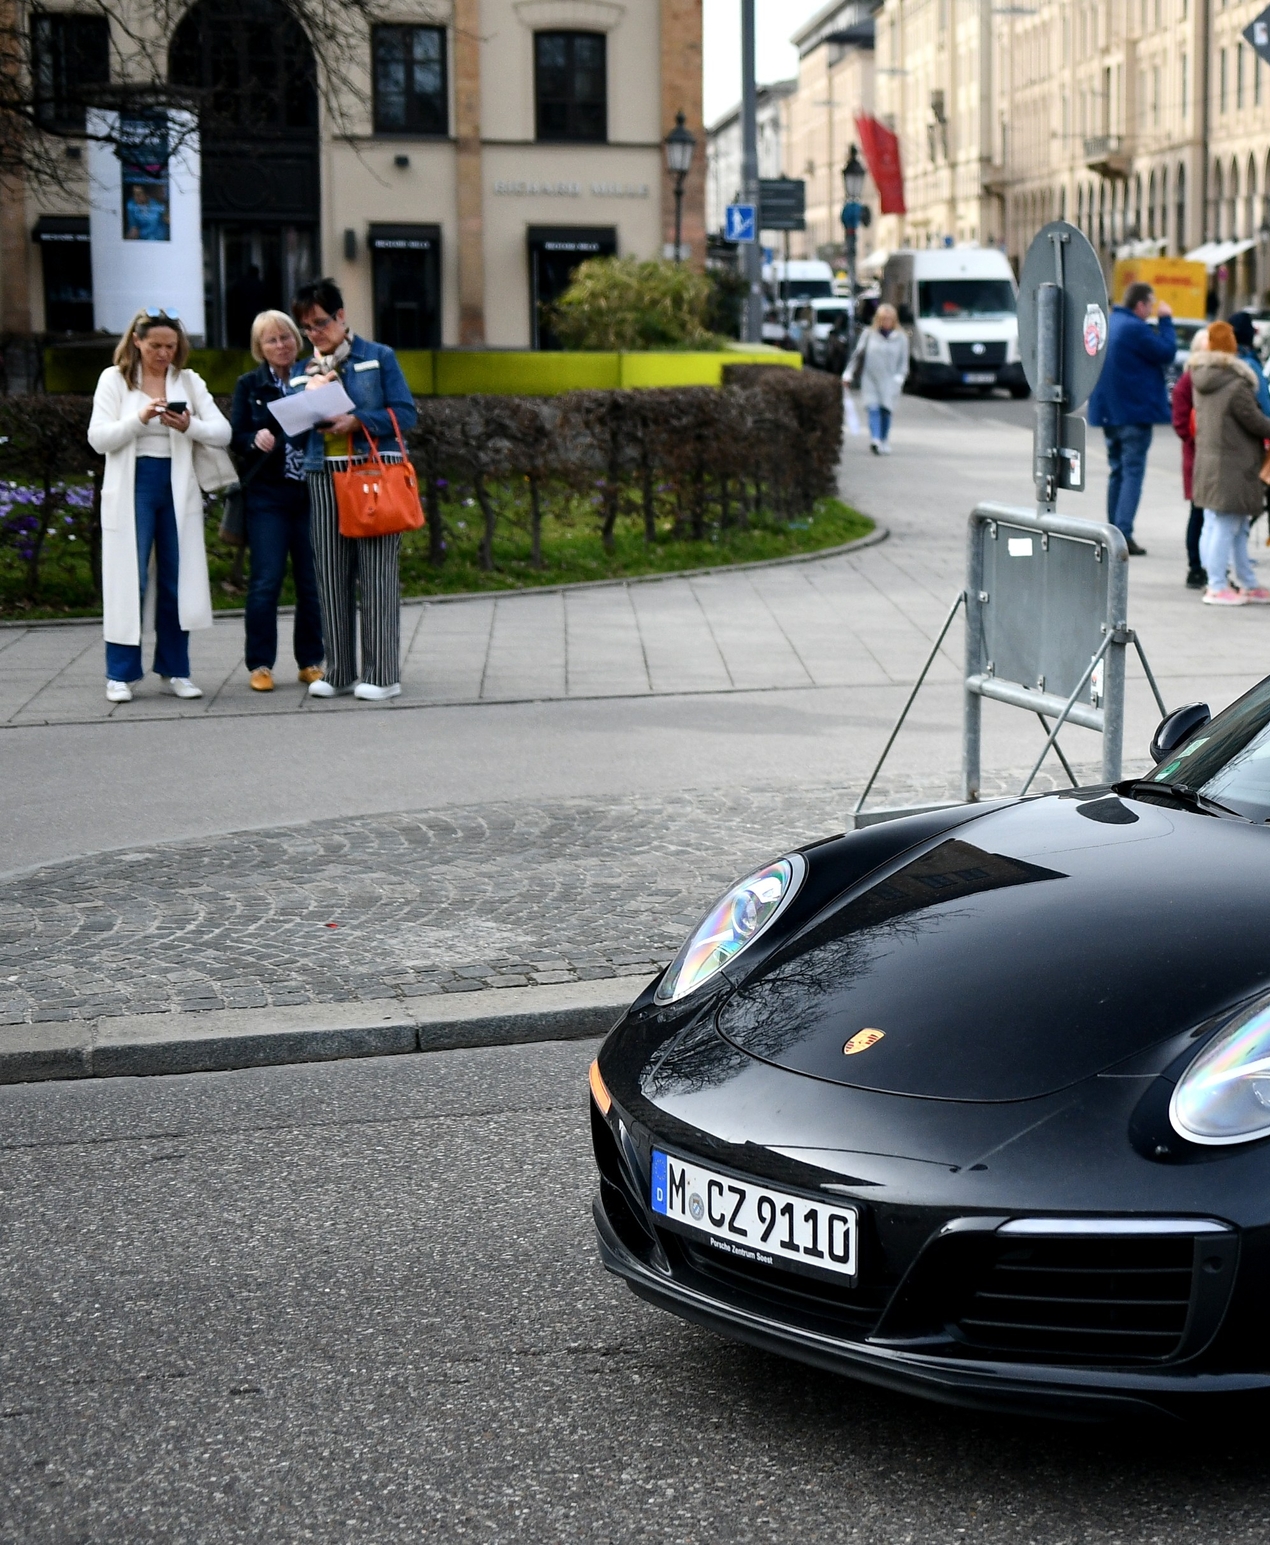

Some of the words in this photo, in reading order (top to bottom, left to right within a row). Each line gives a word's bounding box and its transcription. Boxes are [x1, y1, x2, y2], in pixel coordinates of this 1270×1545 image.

[669, 1163, 686, 1216] M
[707, 1179, 748, 1237] CZ
[757, 1195, 851, 1265] 9110
[710, 1236, 731, 1252] Porsche
[731, 1244, 756, 1259] Zentrum
